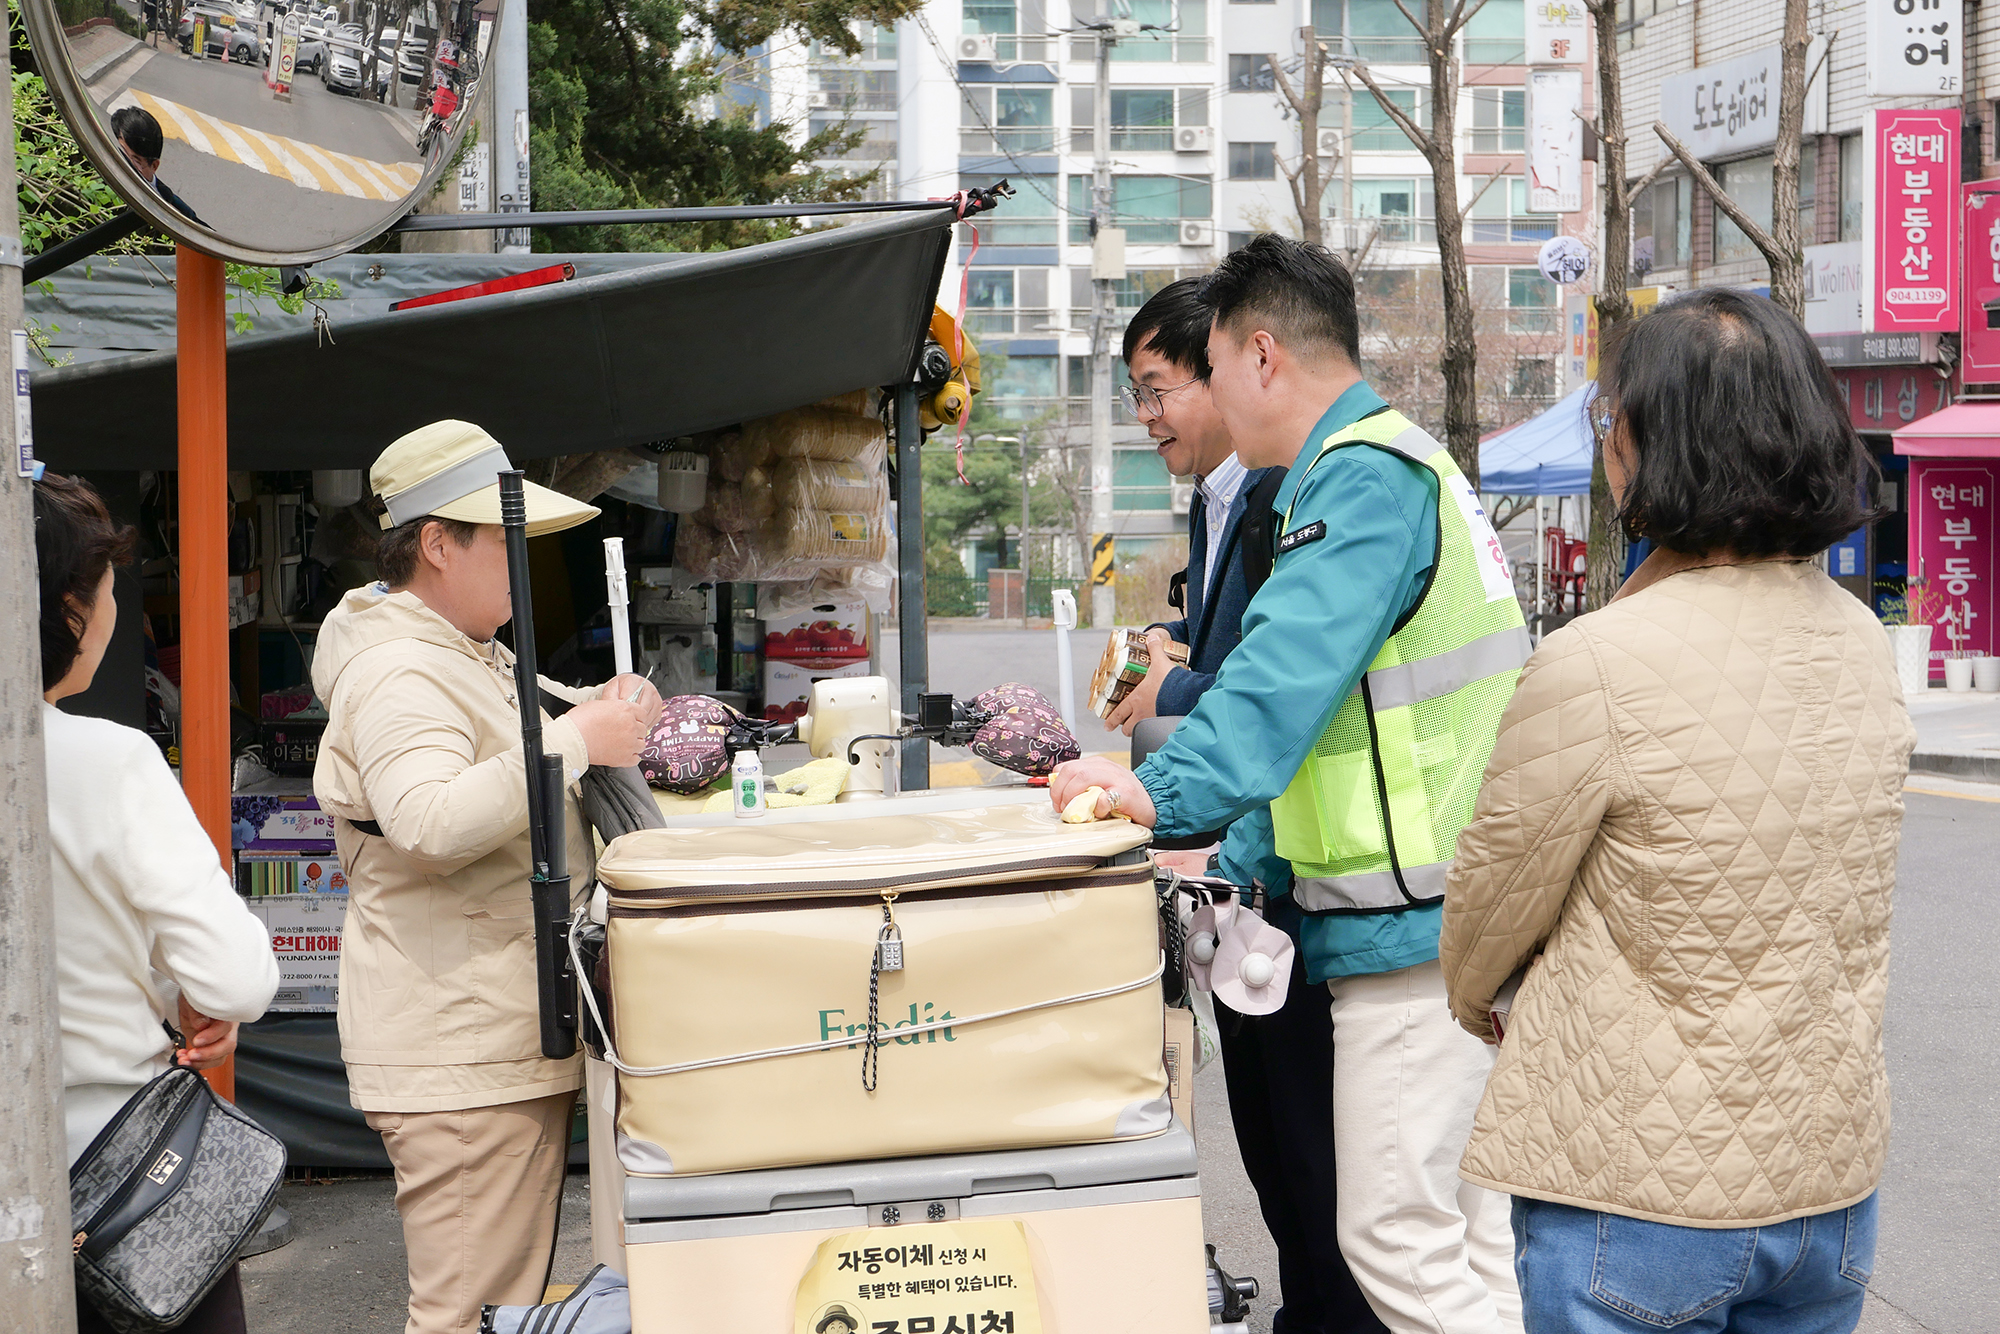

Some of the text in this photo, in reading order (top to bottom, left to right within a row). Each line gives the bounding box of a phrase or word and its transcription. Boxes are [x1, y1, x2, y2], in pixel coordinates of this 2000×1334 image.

[1550, 39, 1570, 59] 3F
[1939, 76, 1958, 91] 2F
[1694, 80, 1766, 136] 도도헤어
[1890, 133, 1945, 165] 현대
[1901, 170, 1933, 281] 부동산
[1863, 338, 1886, 359] 우이점
[1931, 484, 1985, 512] 현대
[1280, 525, 1318, 548] 서울 도봉구
[1937, 516, 1978, 641] 부동산
[661, 735, 721, 747] HAPPY TIME
[274, 926, 304, 934] 서비스인증
[837, 1244, 986, 1274] 자동이체 신청 시
[858, 1275, 1018, 1300] 특별한 혜택이 있습니다.
